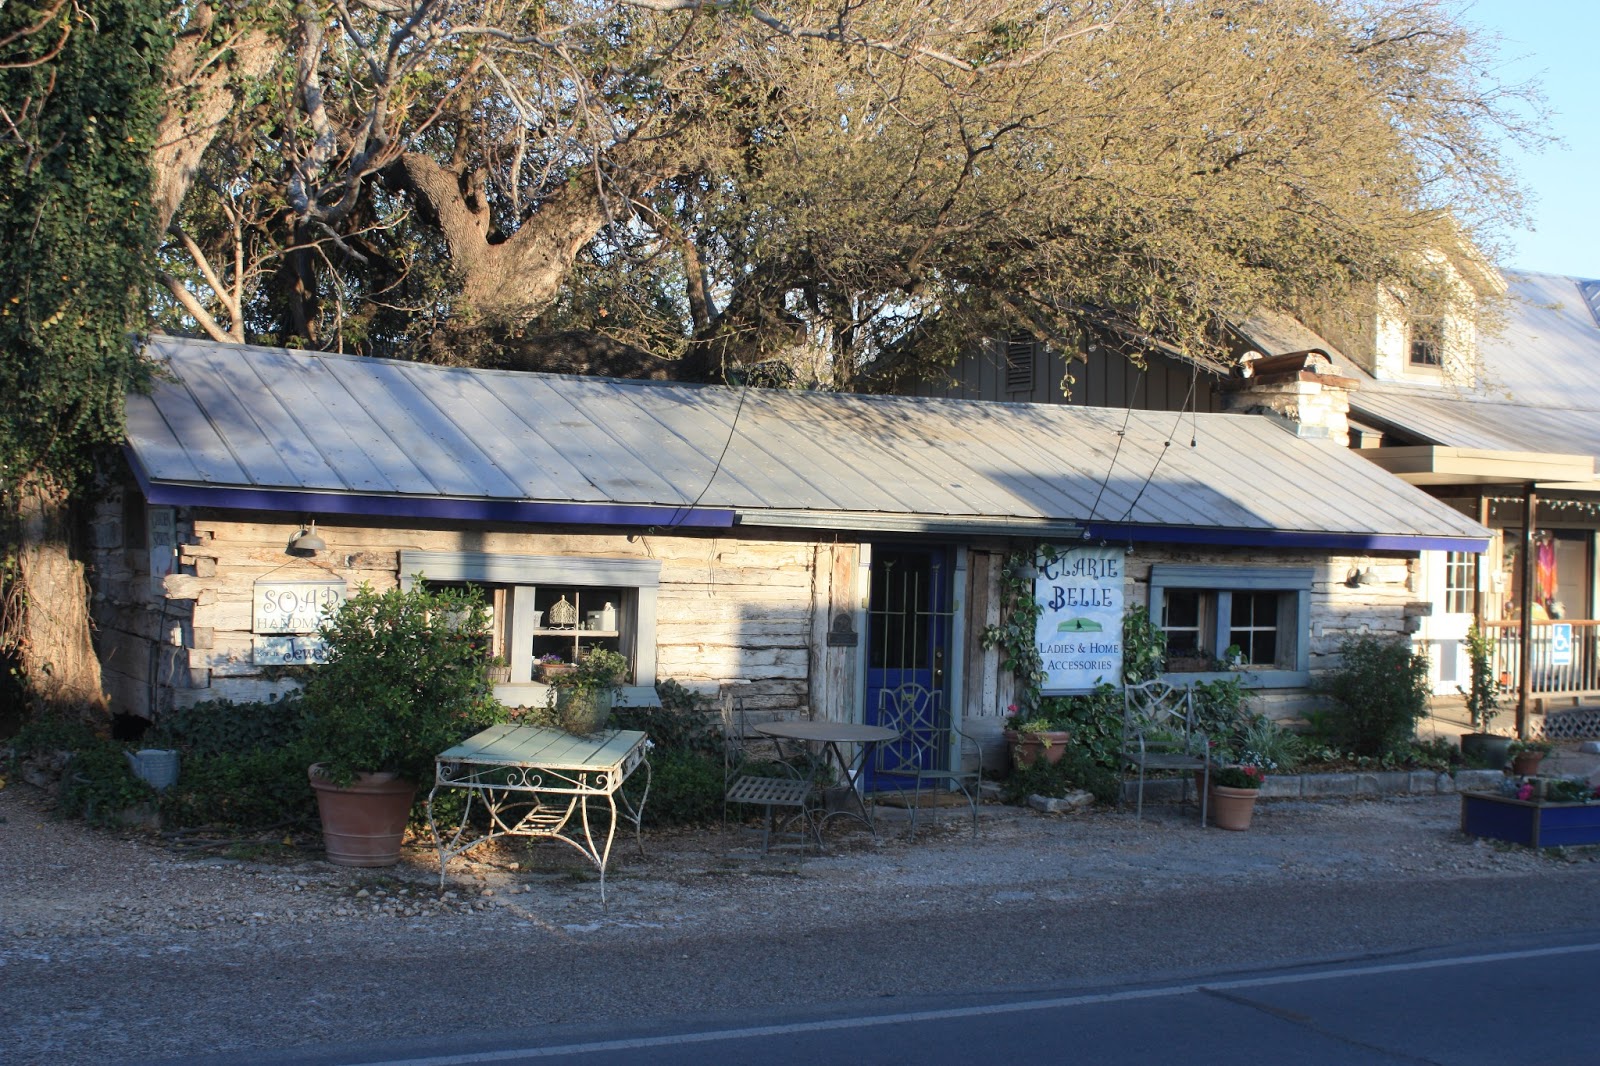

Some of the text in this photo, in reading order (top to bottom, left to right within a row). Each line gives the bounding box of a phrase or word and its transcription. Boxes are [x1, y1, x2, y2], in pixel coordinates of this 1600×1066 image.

[1043, 555, 1118, 580] CLARIE
[263, 587, 339, 613] SOAP
[1048, 586, 1112, 612] BELLE
[257, 617, 334, 629] HANDMAD
[283, 638, 327, 662] Jewel
[1040, 643, 1119, 654] LADIES & HOME
[1047, 660, 1112, 671] ACCESSORIES
